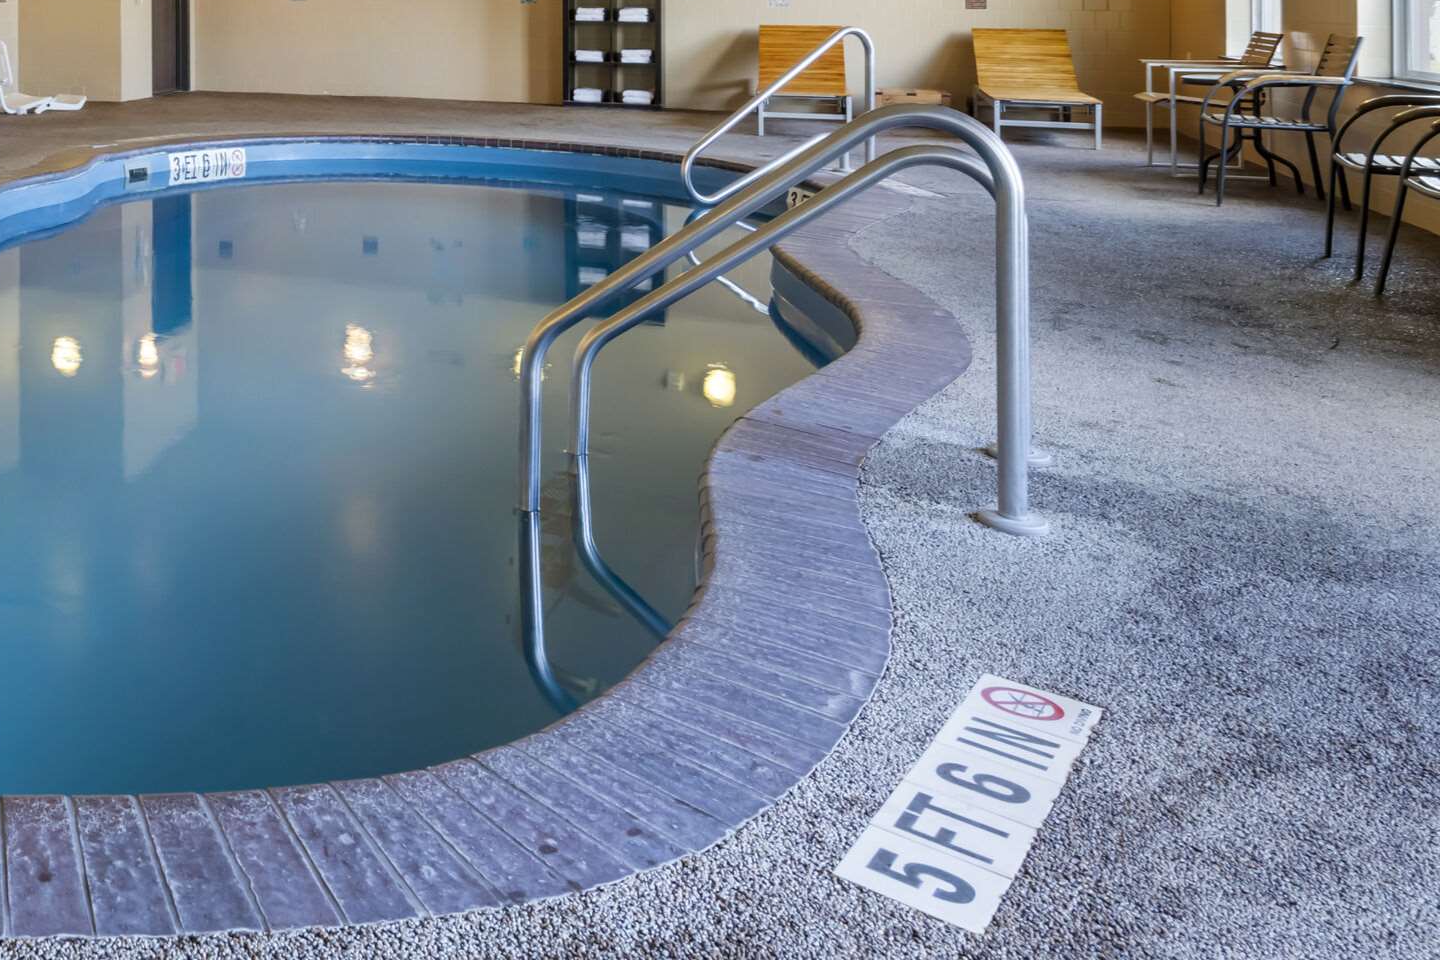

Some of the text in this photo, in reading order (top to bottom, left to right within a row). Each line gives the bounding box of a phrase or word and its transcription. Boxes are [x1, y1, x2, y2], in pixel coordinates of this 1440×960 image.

[866, 716, 1062, 905] 5 FT 6 IN
